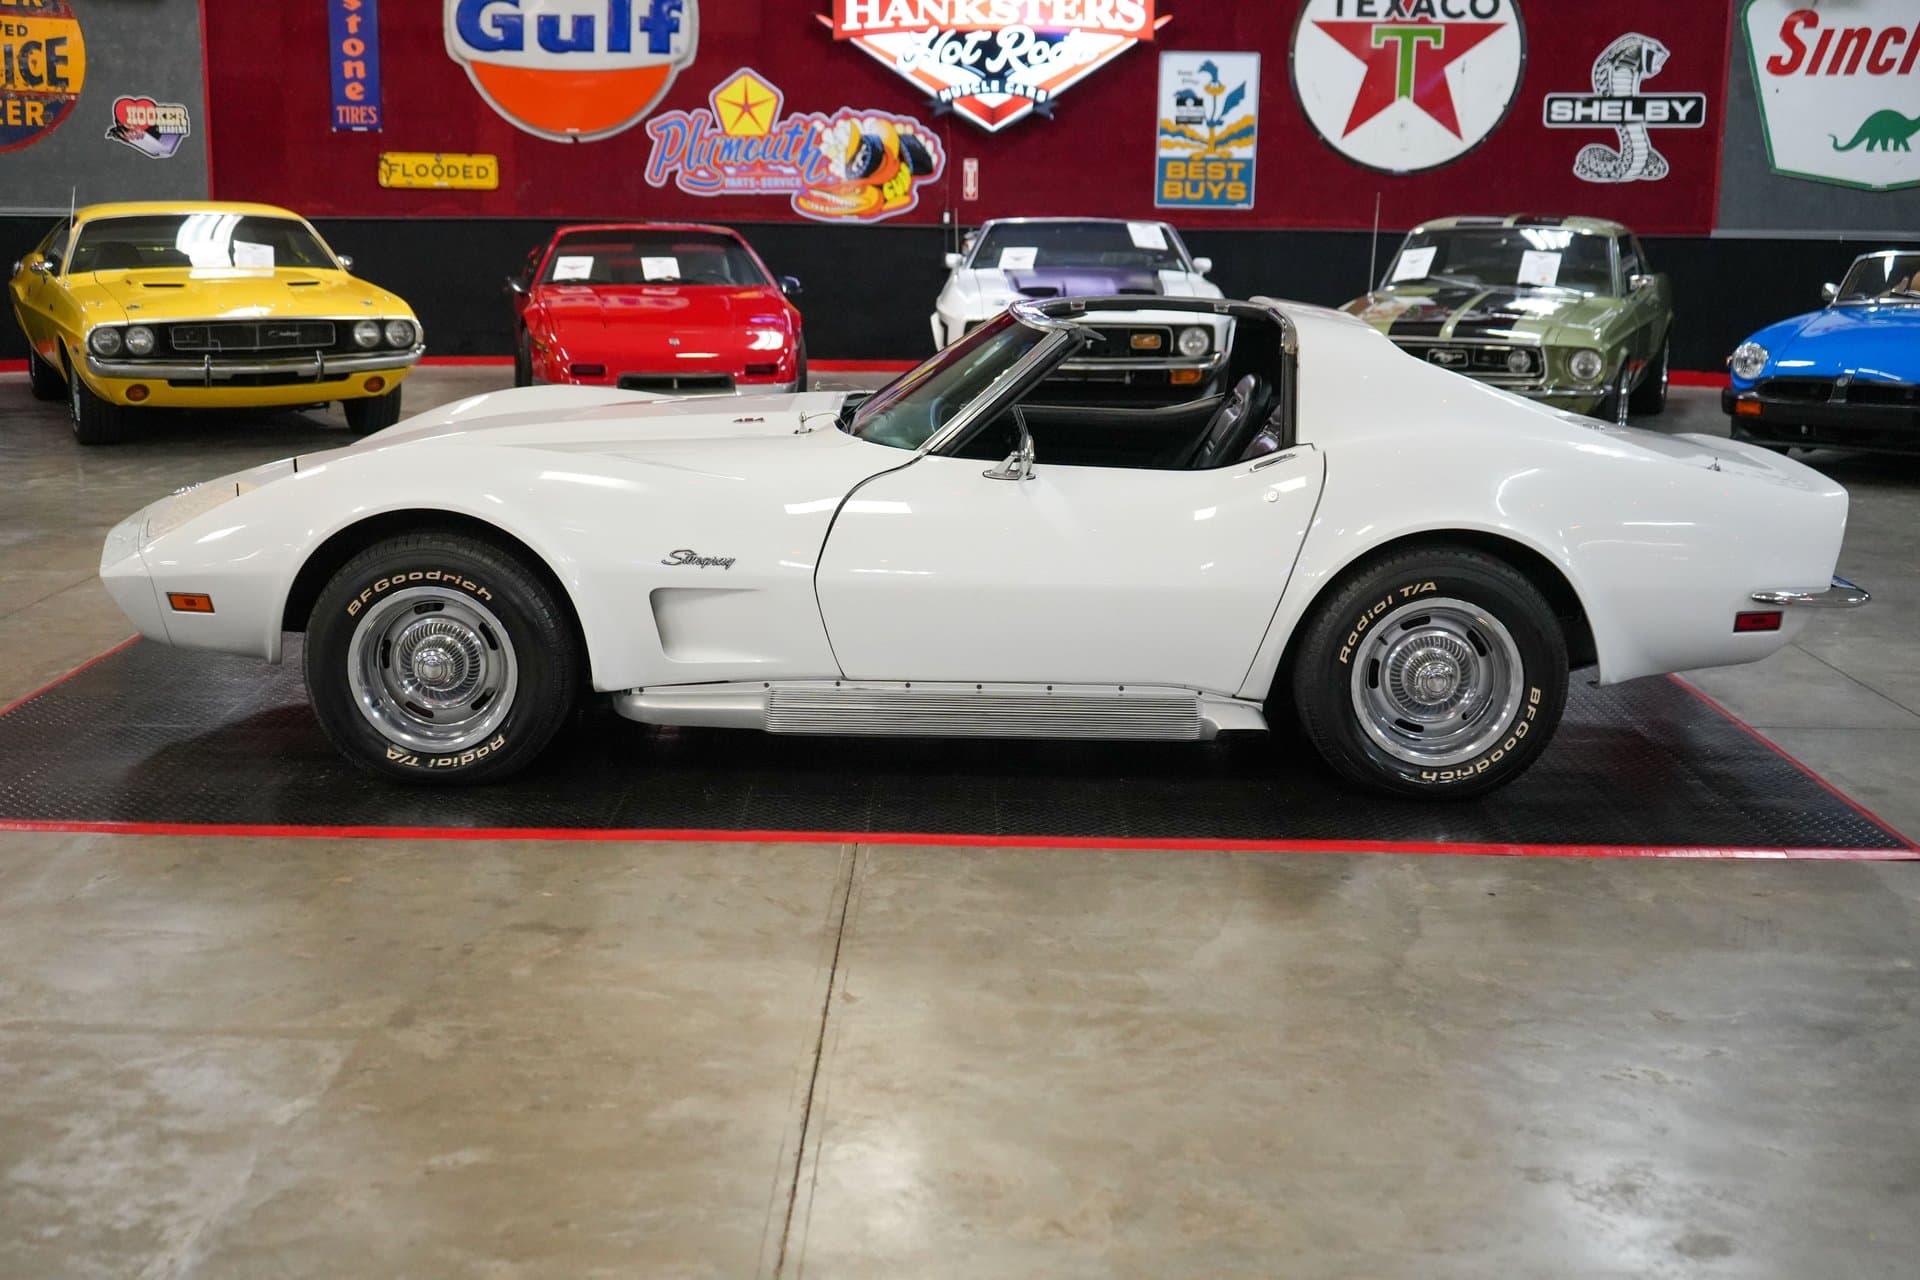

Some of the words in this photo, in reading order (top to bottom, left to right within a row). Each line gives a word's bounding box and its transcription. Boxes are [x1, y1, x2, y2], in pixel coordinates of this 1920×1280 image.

[456, 0, 683, 54] Gulf
[839, 0, 1147, 31] HANKSTERS
[0, 23, 28, 37] ED
[896, 25, 993, 73] Hot
[938, 80, 999, 102] MUSCLE
[1004, 81, 1048, 102] CARS
[0, 100, 46, 127] ER
[126, 105, 187, 127] HOOKER
[336, 105, 379, 124] TIRES
[1550, 100, 1697, 122] SHELBY
[655, 117, 826, 188] Plymouth
[387, 163, 490, 181] FLOODED
[1166, 161, 1246, 180] BEST
[1163, 181, 1247, 201] BUYS
[347, 570, 493, 617] BFGoodrich
[1339, 595, 1393, 665] Radial
[1399, 581, 1438, 597] T/A
[1421, 687, 1542, 782] BFGoodrich
[385, 743, 420, 768] T/A
[428, 734, 506, 768] Radial
